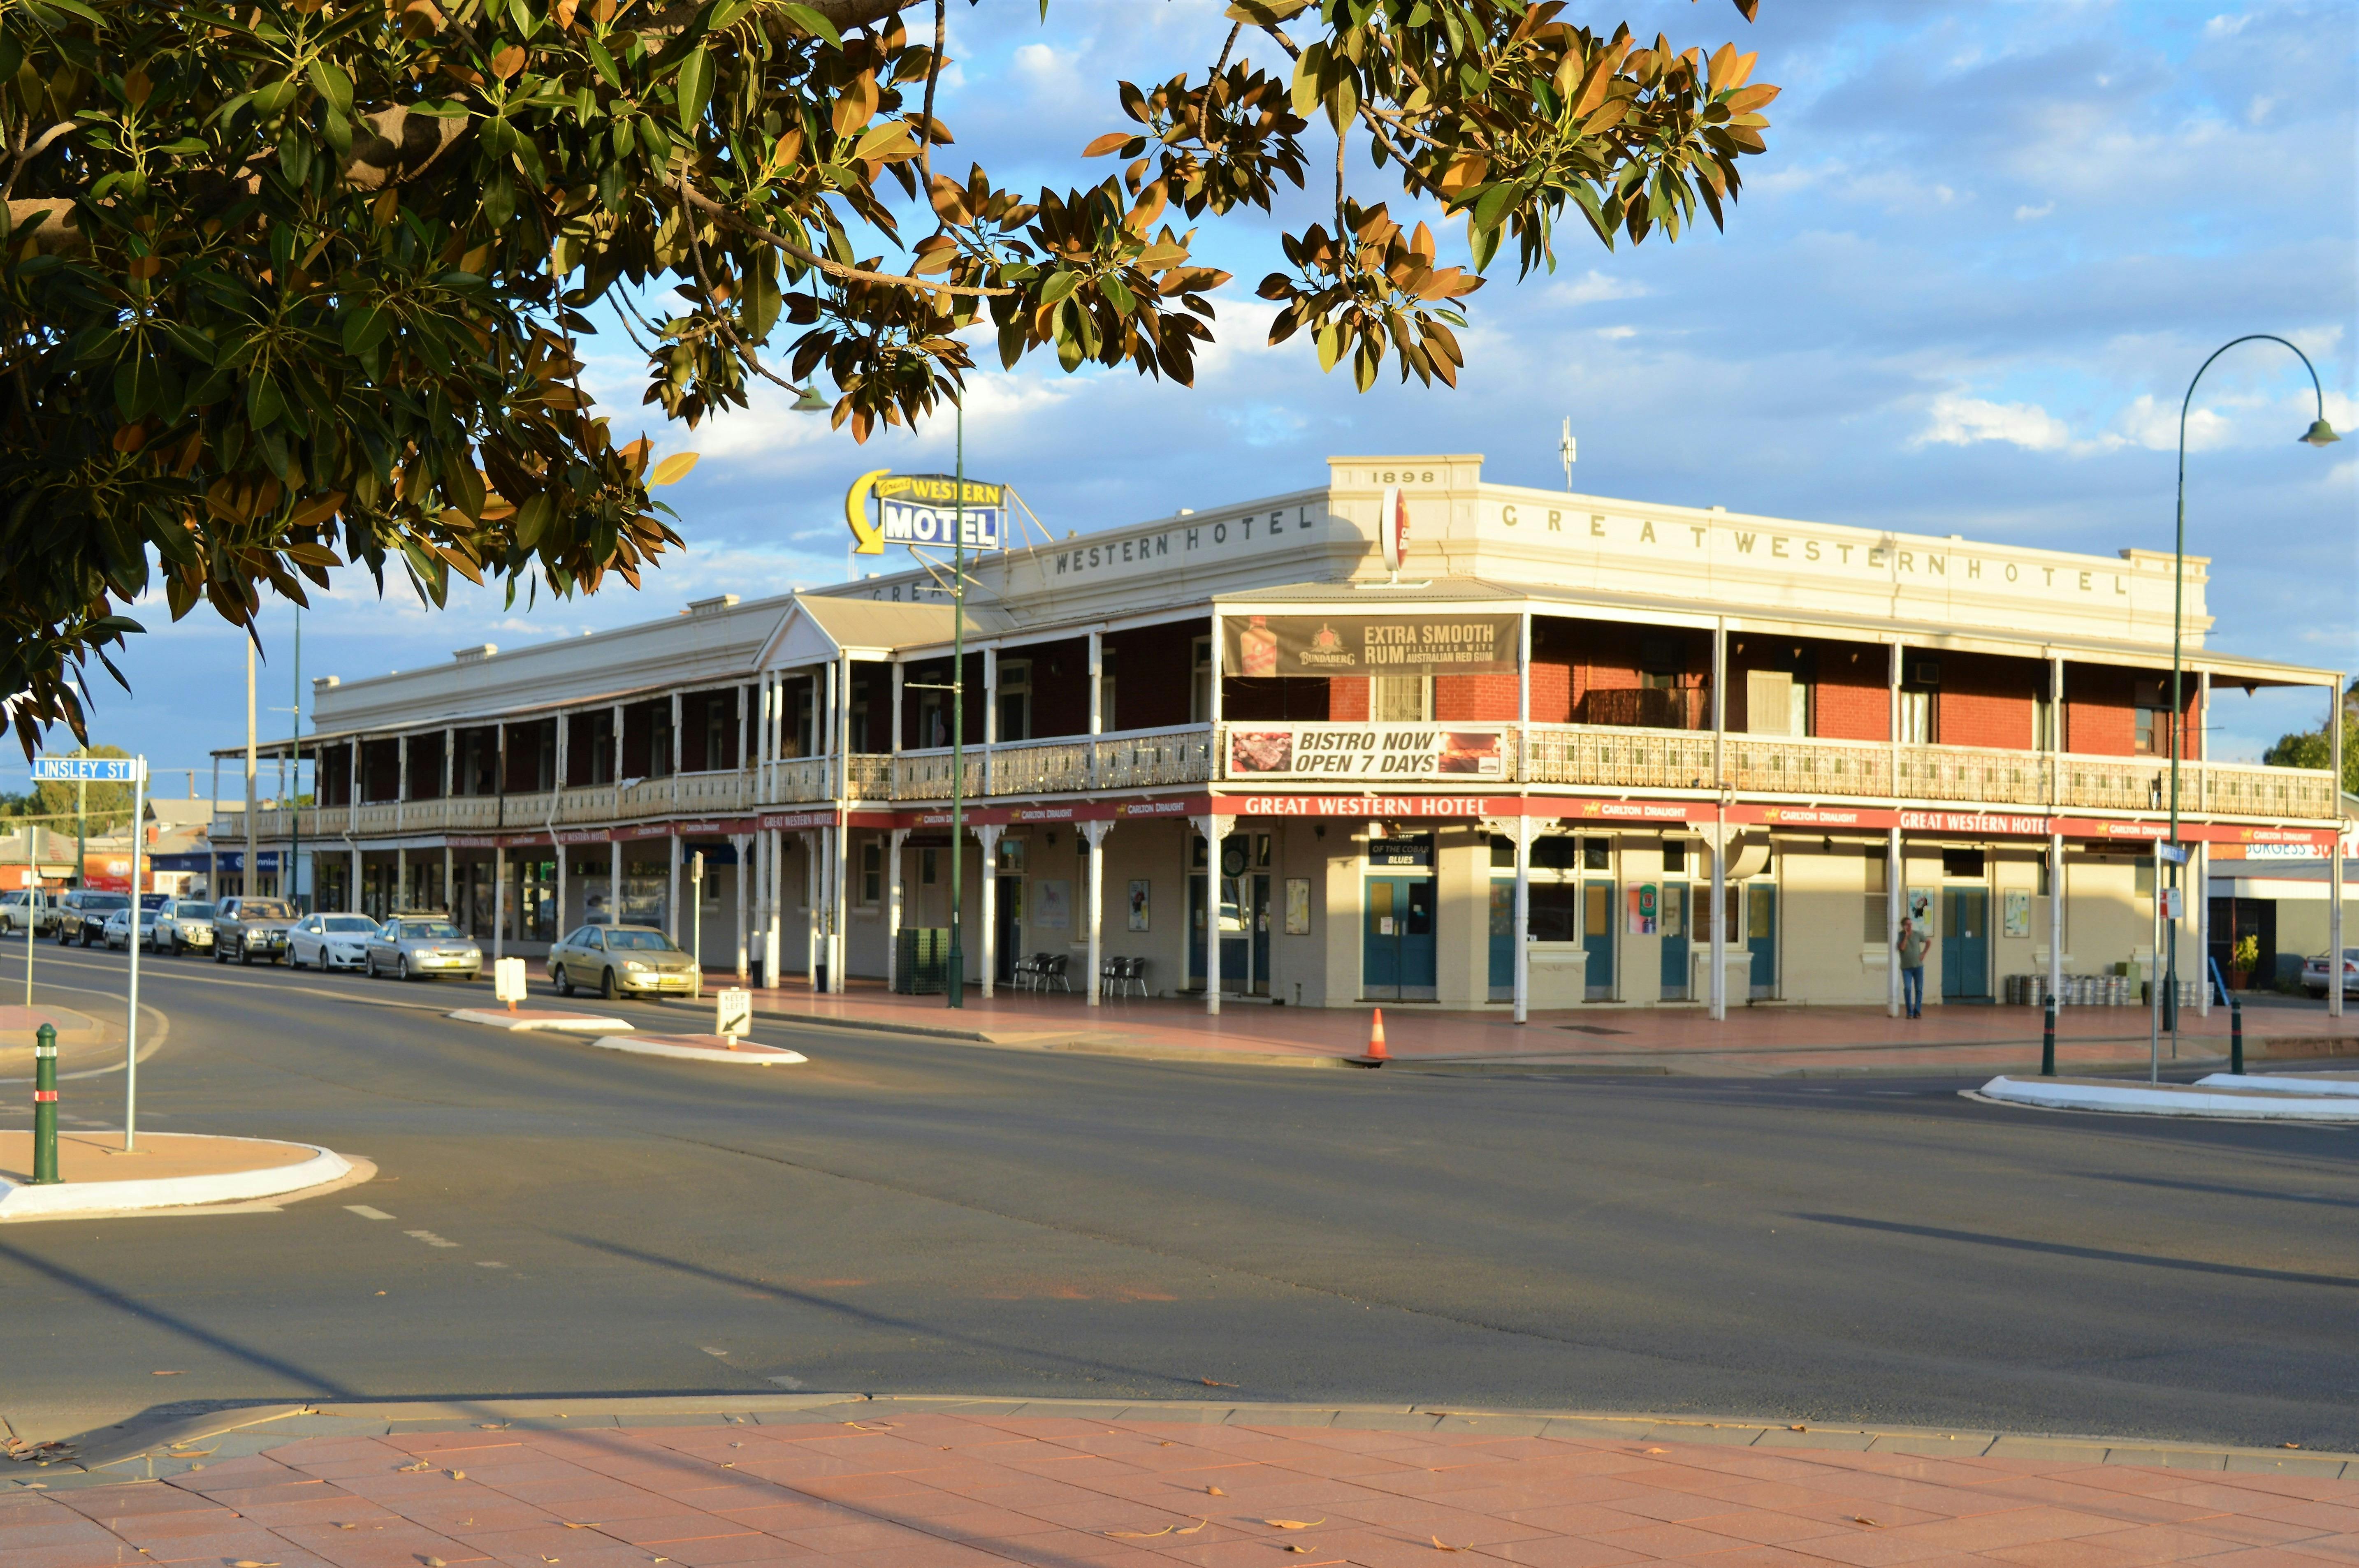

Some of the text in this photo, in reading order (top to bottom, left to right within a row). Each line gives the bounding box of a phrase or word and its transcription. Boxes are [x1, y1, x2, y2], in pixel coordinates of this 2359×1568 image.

[1373, 472, 1434, 483] 1898
[912, 480, 1000, 504] WESTERN
[885, 506, 996, 545] MOTEL
[873, 507, 1312, 602] GREA WESTERN HOTEL
[1502, 505, 2127, 595] GREAT WESTERN HOTEL
[1364, 624, 1494, 644] EXTRA SMOOTH
[1365, 645, 1404, 664] RUM
[1406, 644, 1493, 653] FILTERED WITH
[1299, 651, 1355, 665] BUNDABERG
[1406, 651, 1494, 663] AUSTRALIAN RED GUM
[1299, 732, 1435, 750] BISTRO NOW
[35, 761, 126, 778] LINSLEY ST
[1295, 754, 1436, 773] OPEN 7 DAYS
[1127, 802, 1185, 814] CARLTON DRAUGHT
[1245, 798, 1487, 814] GREAT WESTERN HOTEL
[1601, 804, 1686, 817] CARLTON DRAUGHT
[764, 813, 833, 827] GREAT WESTERN HOTEL
[1022, 809, 1072, 820] CARLTON DRAUGHT
[1780, 810, 1857, 823] CARLTON DRAUGHT
[1900, 812, 2053, 834] GREAT WESTERN HOTEL
[2109, 824, 2171, 836] CARLTON DRAUGH
[2253, 830, 2312, 842] CARLTON DRAUGHT
[1388, 855, 1414, 864] BLUES
